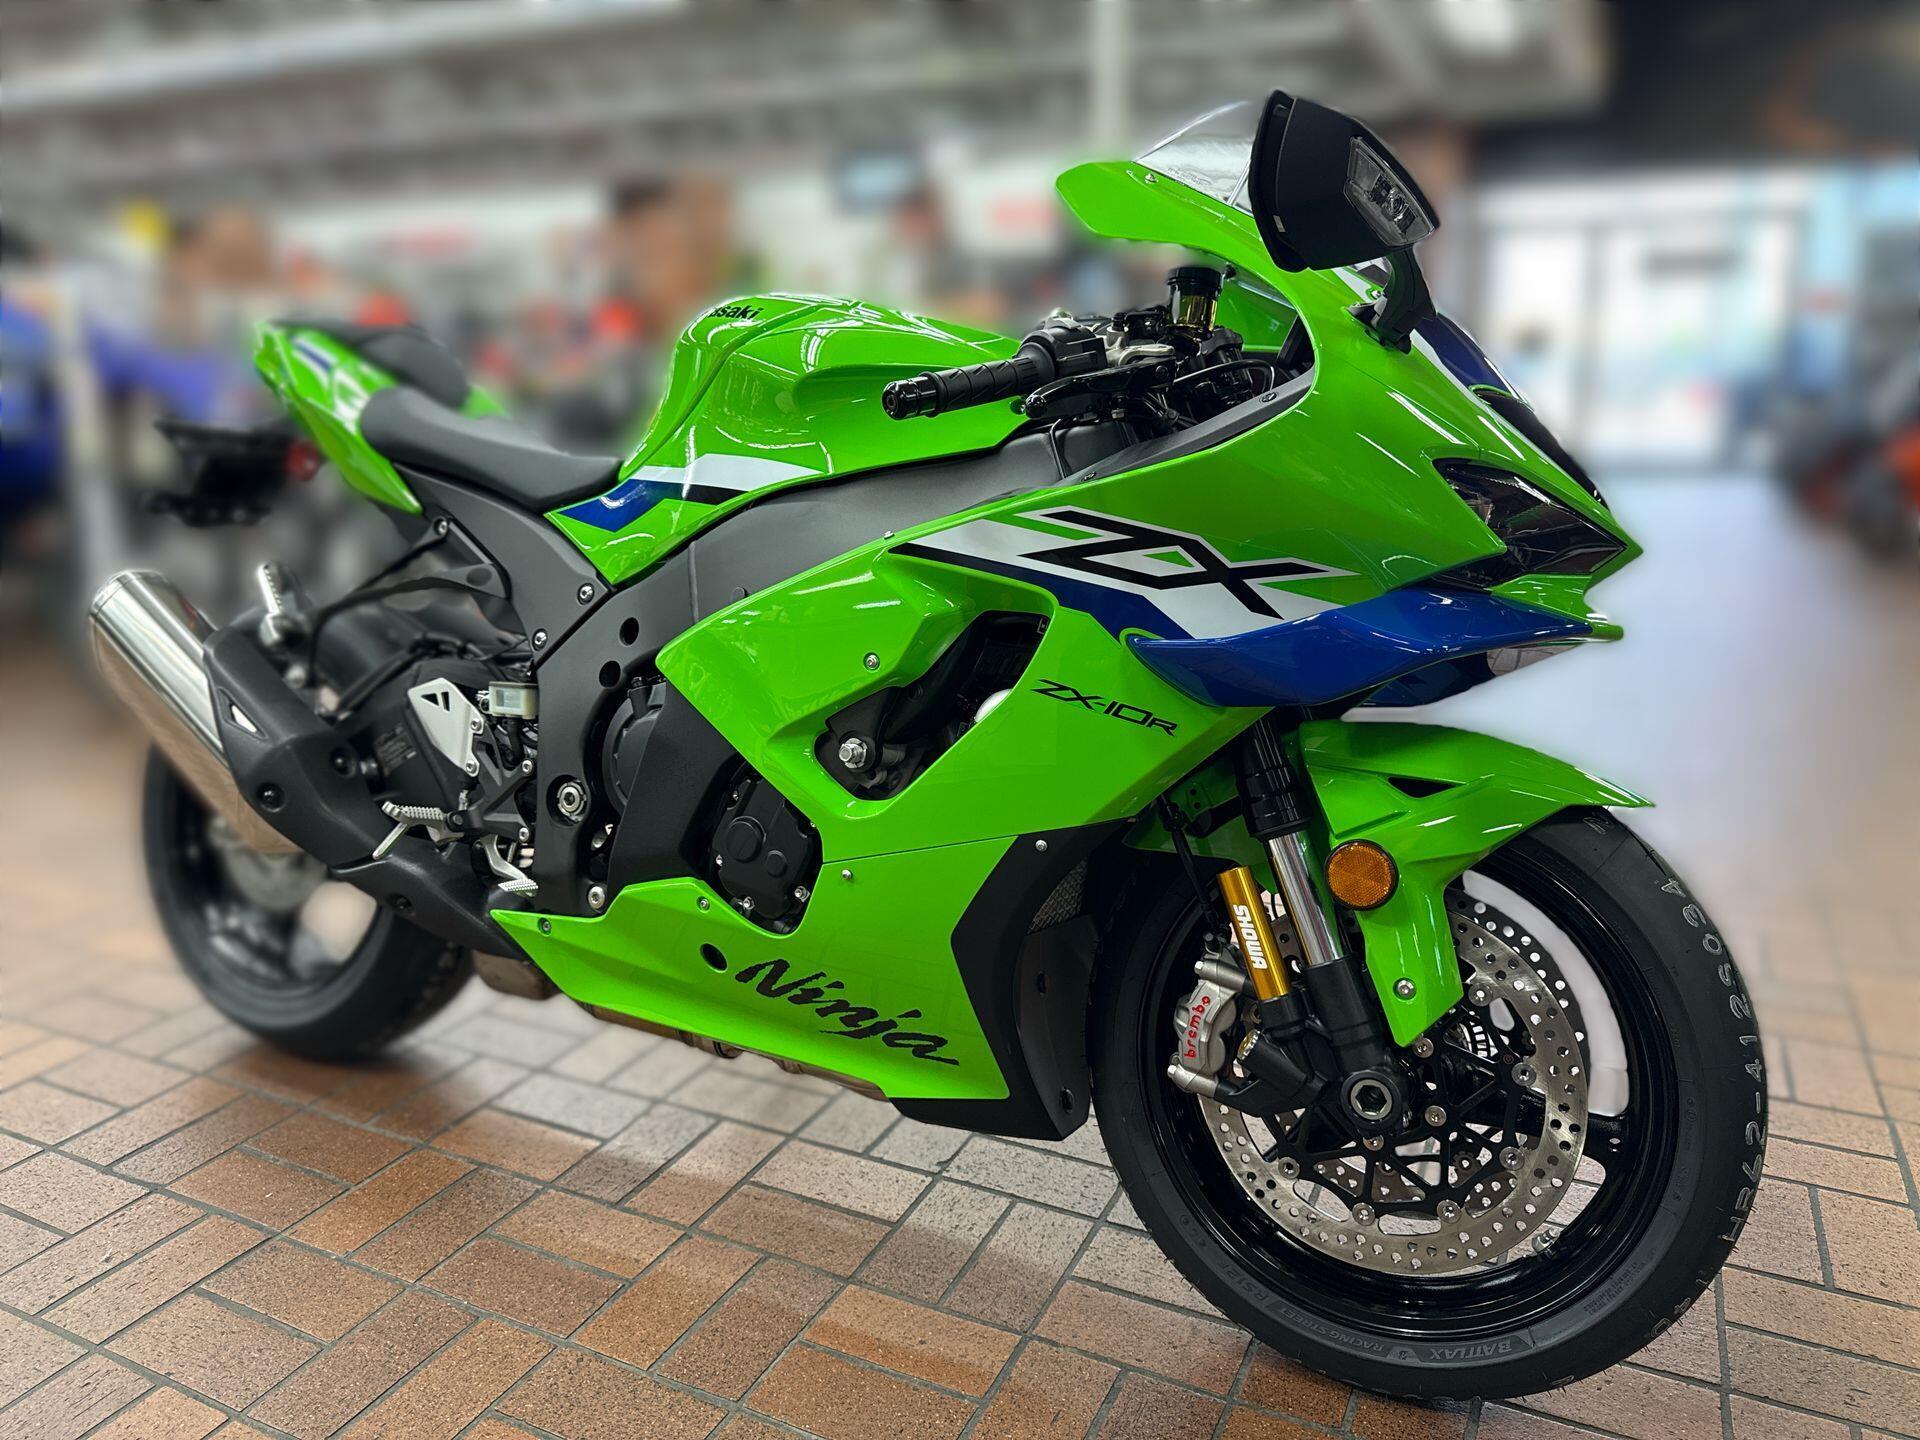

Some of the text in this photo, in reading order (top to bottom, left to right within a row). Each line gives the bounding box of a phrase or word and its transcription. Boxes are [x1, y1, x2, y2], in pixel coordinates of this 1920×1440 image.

[1017, 510, 1330, 620] ZX
[1031, 679, 1179, 737] ZX-10R
[1232, 904, 1269, 970] SHOWA
[735, 959, 960, 1066] Ninja
[1184, 995, 1211, 1059] brembo
[1279, 1307, 1385, 1351] RACING STREET
[1429, 1335, 1512, 1361] BATTLAX
